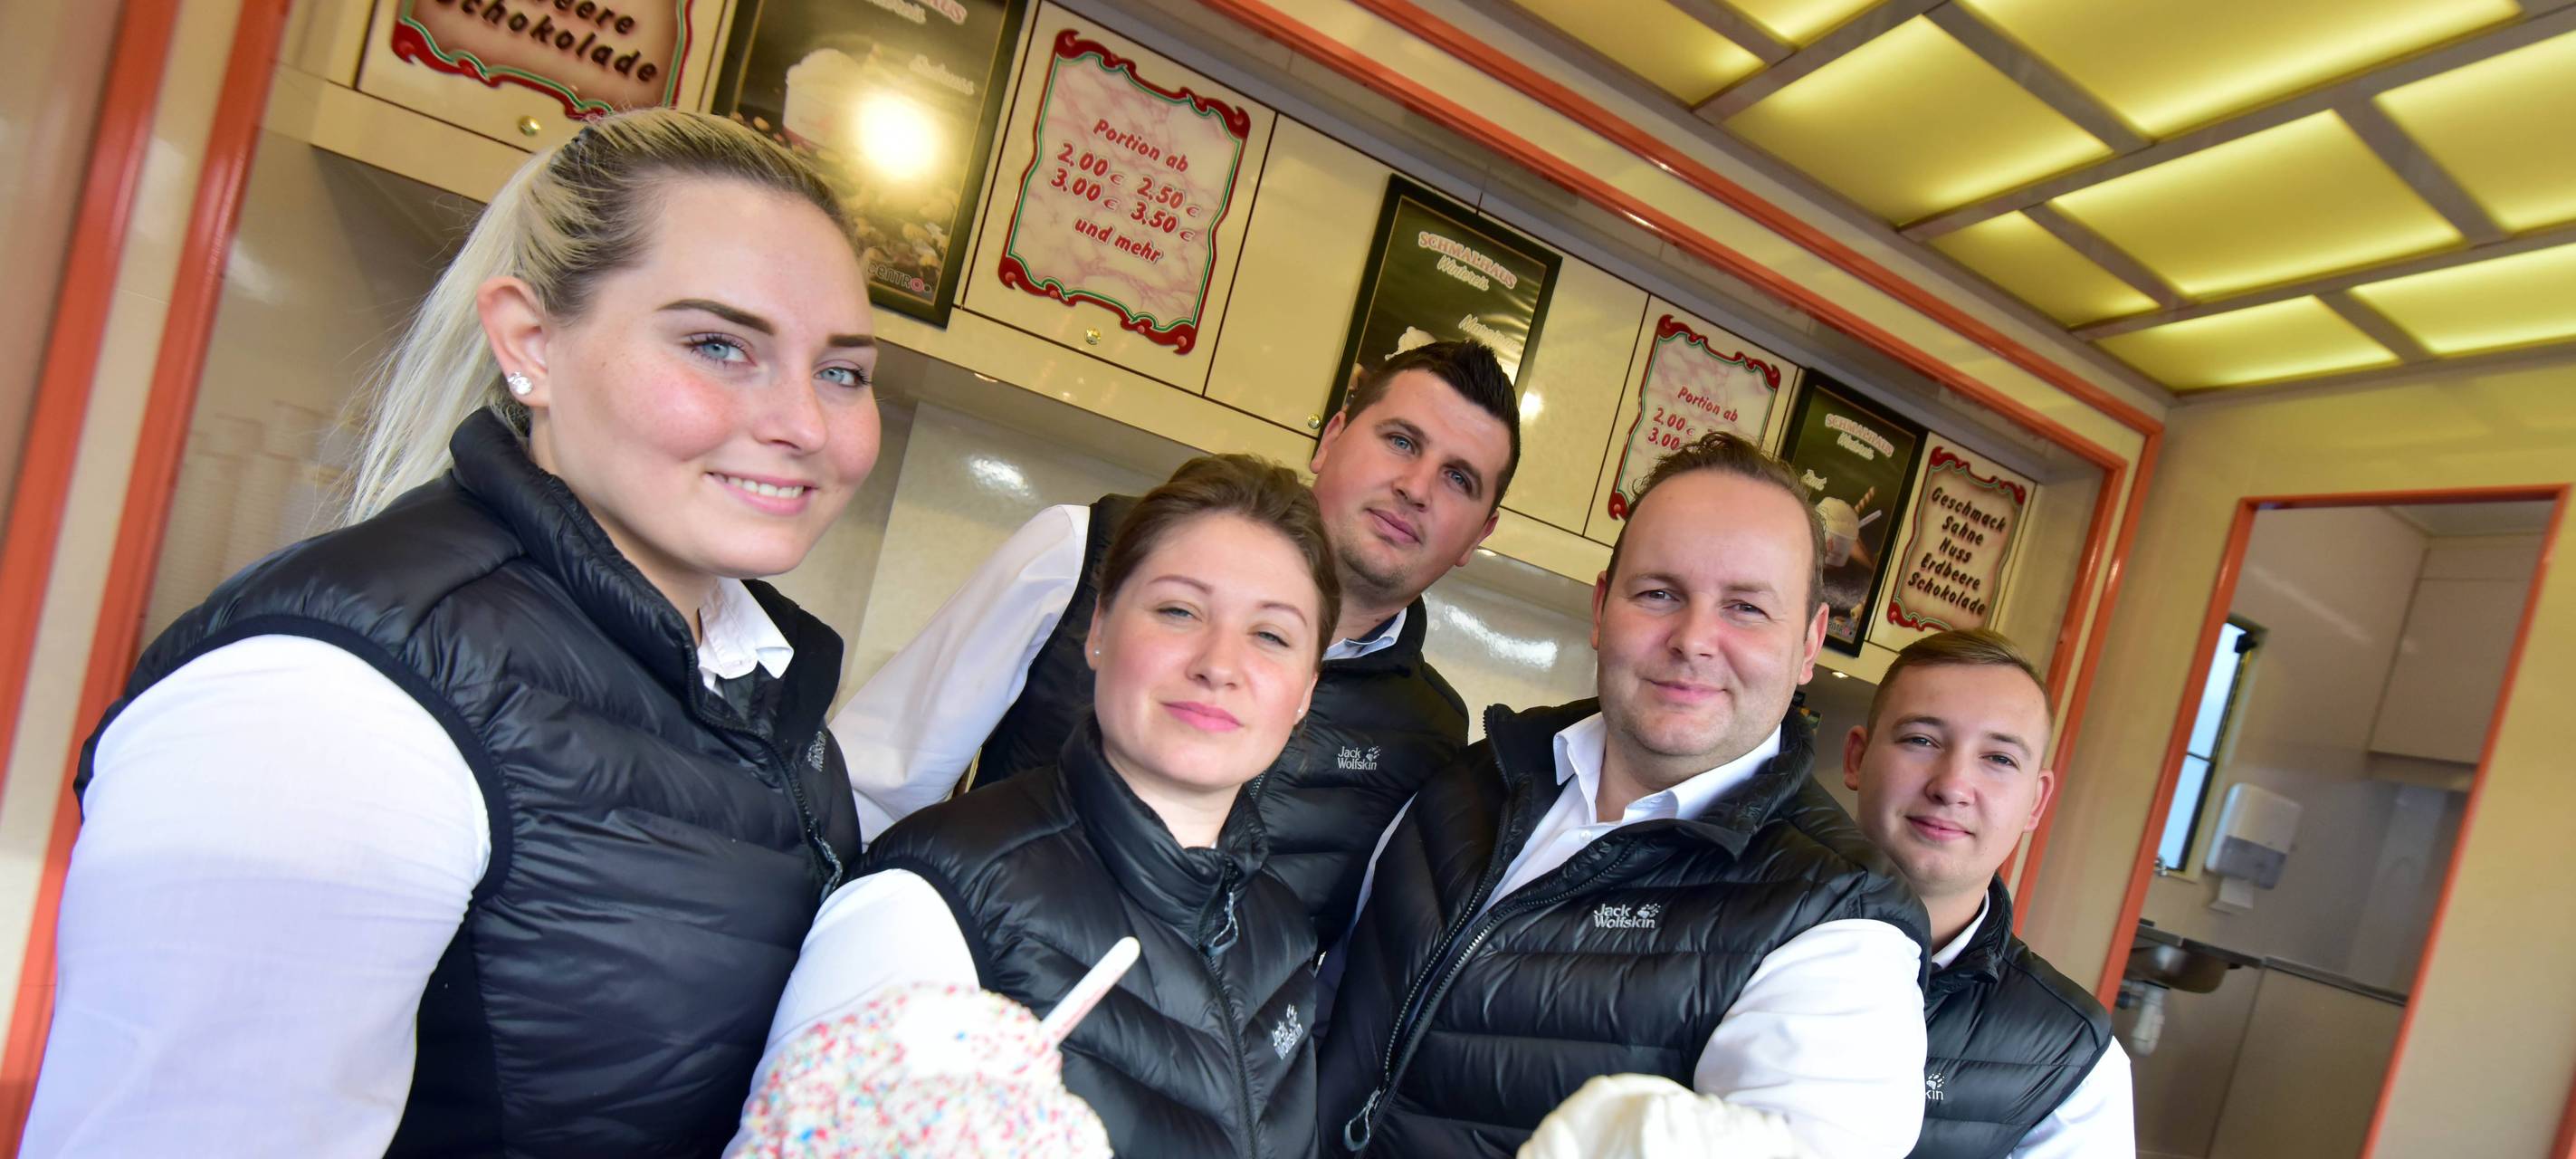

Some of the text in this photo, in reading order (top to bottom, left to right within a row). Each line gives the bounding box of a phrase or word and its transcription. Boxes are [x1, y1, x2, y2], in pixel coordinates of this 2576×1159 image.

[436, 0, 658, 81] chokolade
[1092, 119, 1188, 172] Portion ab
[1074, 218, 1162, 262] und mehr
[1418, 231, 1517, 289] SCHMALHAUS
[1677, 386, 1738, 422] Portion ab
[1932, 487, 2006, 532] Geschmack
[1942, 516, 1983, 544] Sahne
[1939, 537, 1971, 563] Nuss
[1920, 552, 1980, 590] Erdbeere
[1907, 571, 1985, 615] Schokolade
[1338, 746, 1360, 758] Jack
[1338, 757, 1377, 770] Wolfskin
[1594, 904, 1631, 916] Jack
[1594, 915, 1655, 928] Wolfskin
